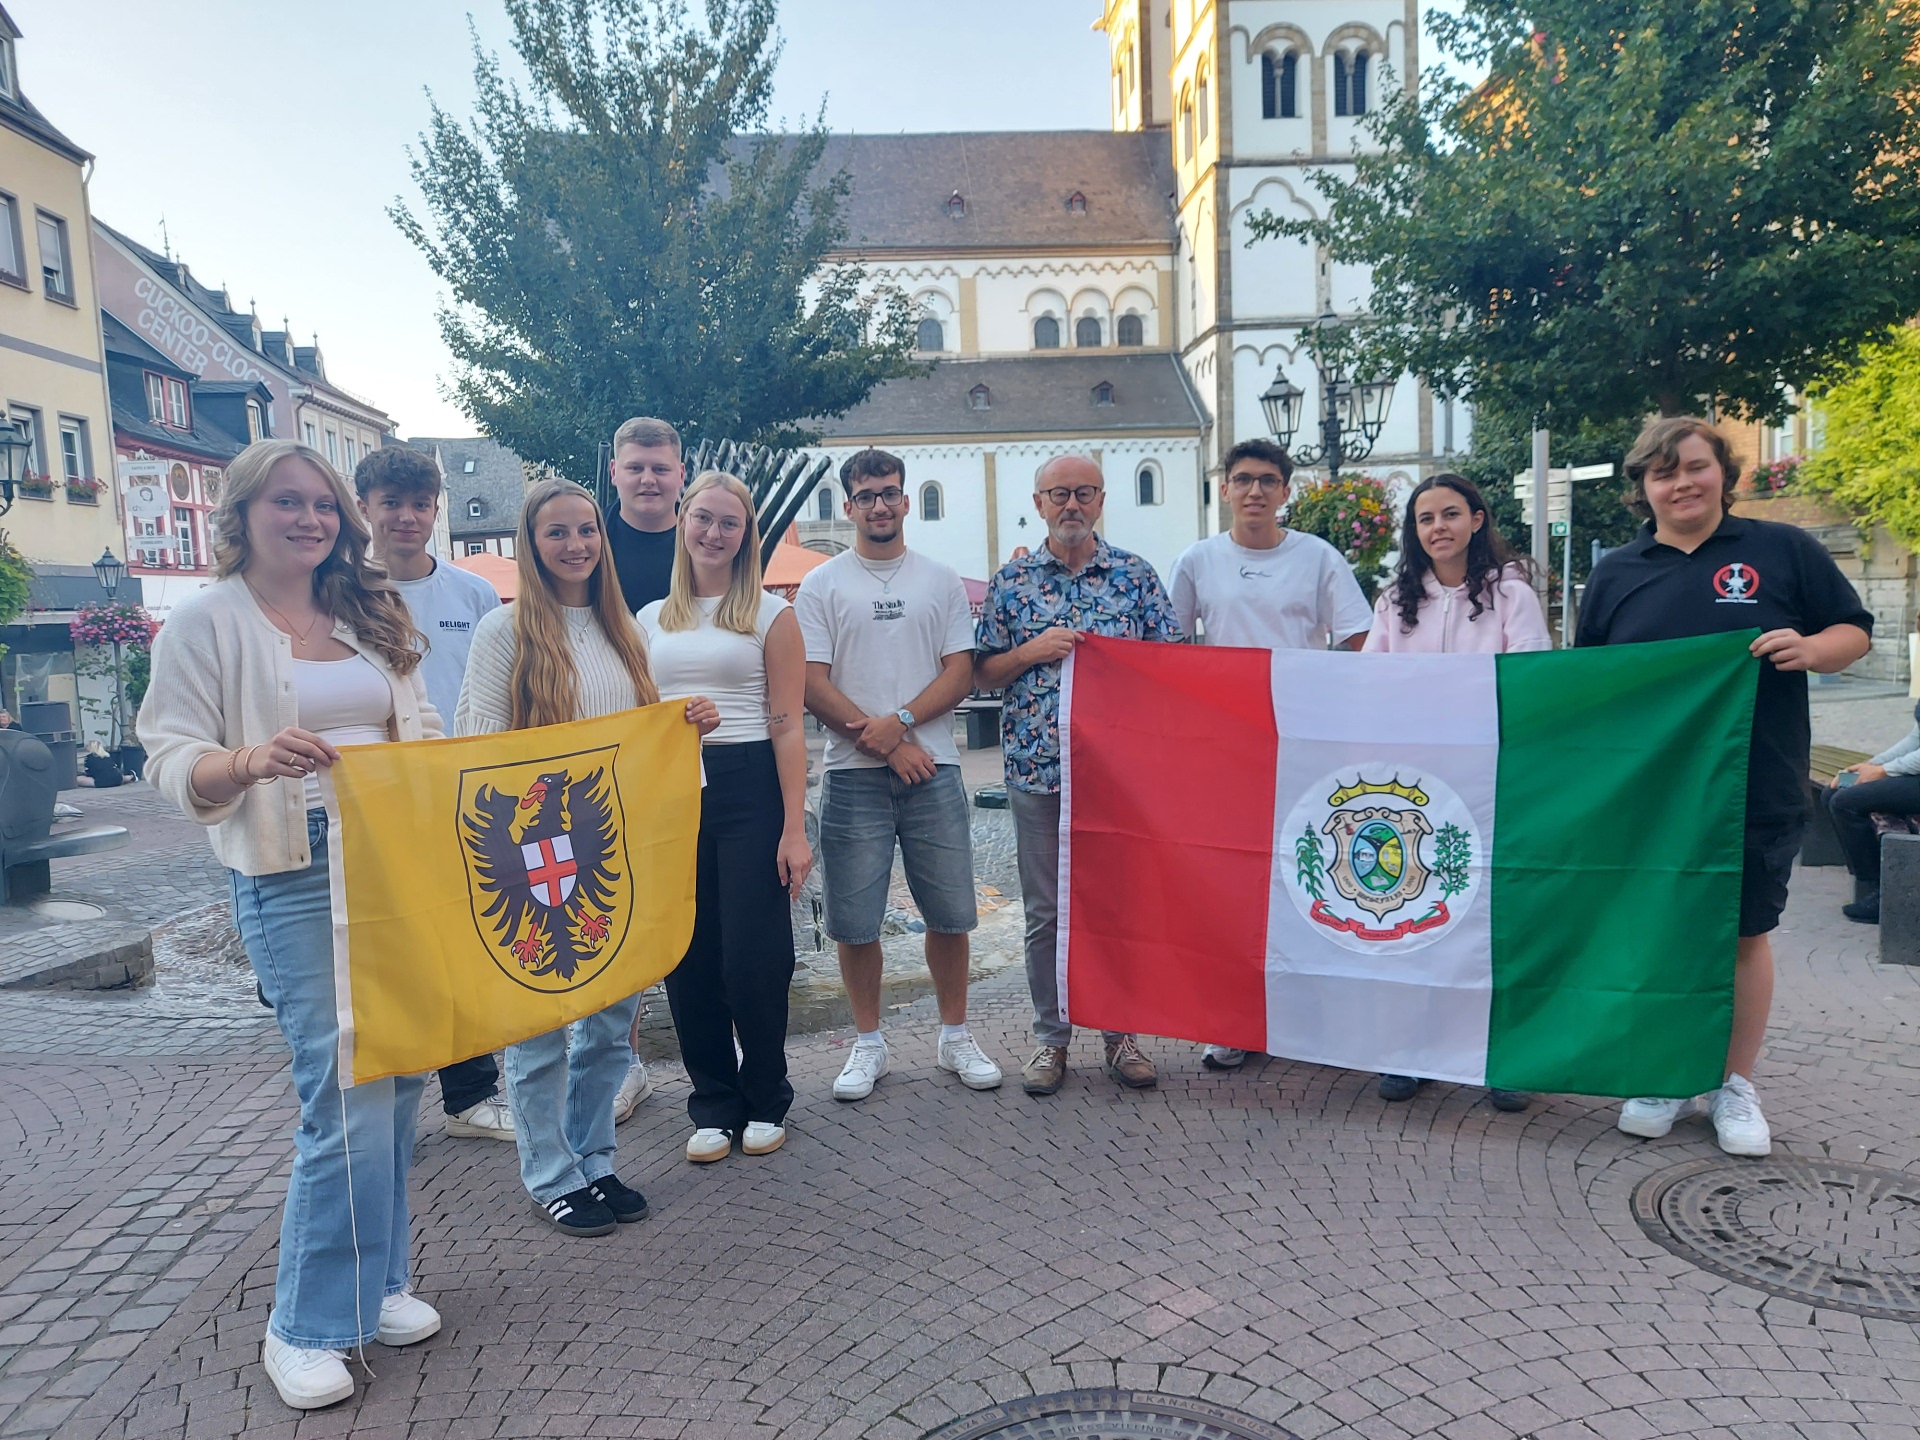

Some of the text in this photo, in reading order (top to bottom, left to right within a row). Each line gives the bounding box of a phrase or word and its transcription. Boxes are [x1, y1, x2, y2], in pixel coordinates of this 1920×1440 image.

[137, 309, 209, 376] CENTER
[872, 600, 885, 609] The
[439, 621, 470, 629] DELIGHT
[1146, 1394, 1277, 1437] KANAL GUSS
